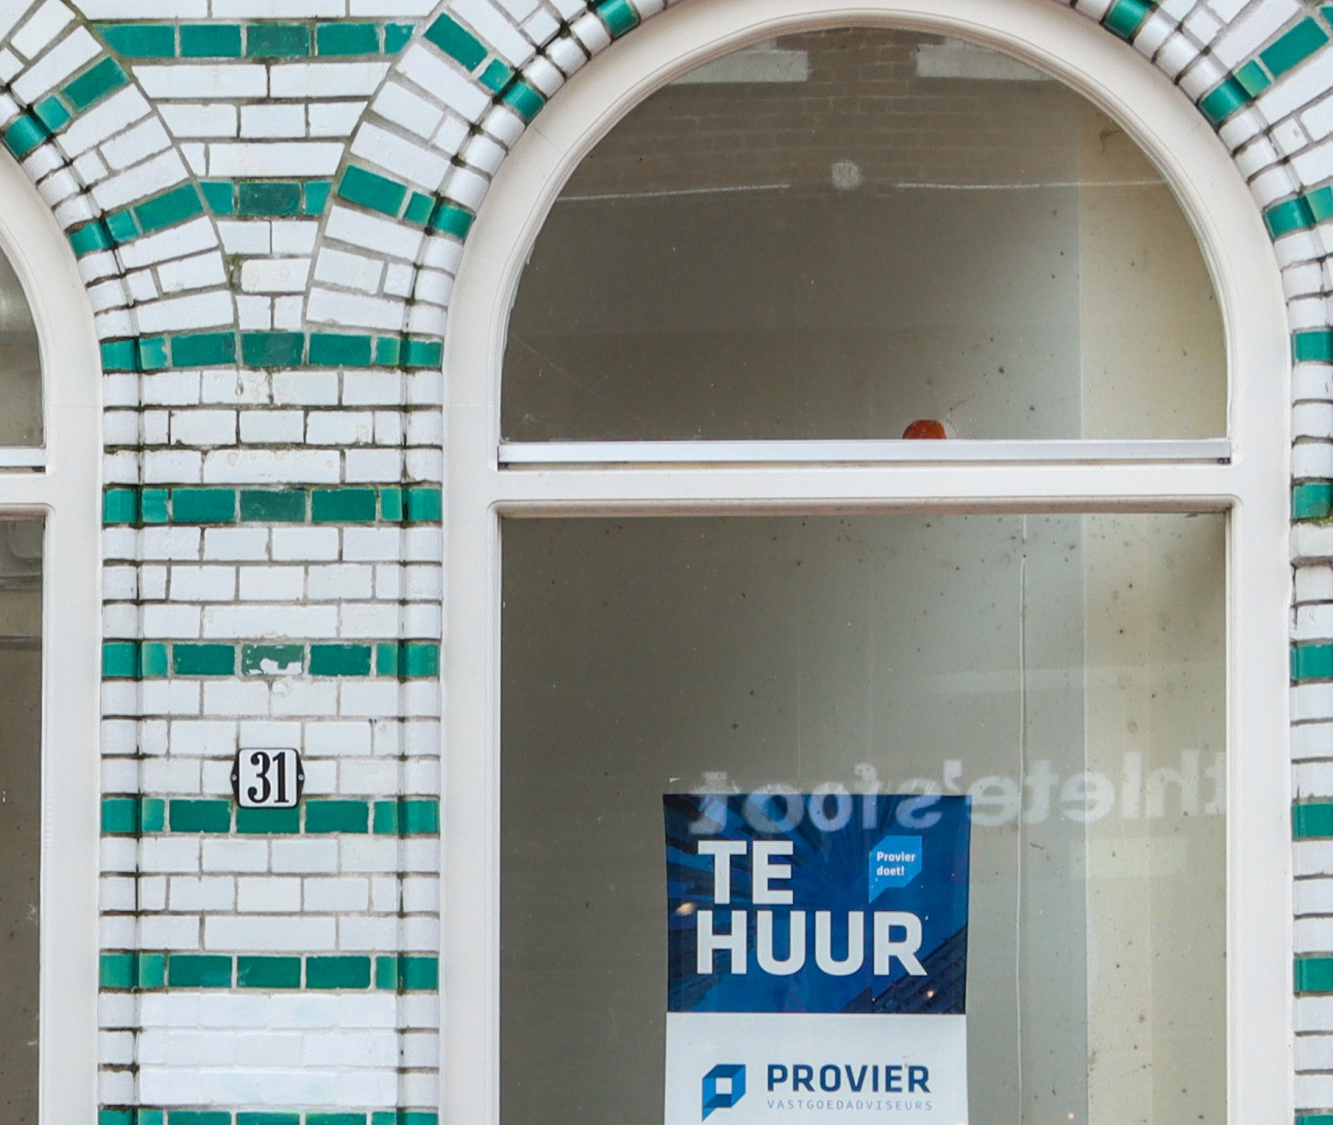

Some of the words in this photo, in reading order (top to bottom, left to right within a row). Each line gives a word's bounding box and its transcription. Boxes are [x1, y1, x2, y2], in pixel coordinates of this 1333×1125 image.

[247, 751, 290, 804] 31
[876, 851, 916, 863] Provier
[876, 864, 905, 877] doet!
[697, 840, 794, 905] TE
[696, 910, 928, 976] HUUR
[766, 1064, 931, 1094] PROVIER
[767, 1099, 933, 1111] VASTGOEDADVISEURS
